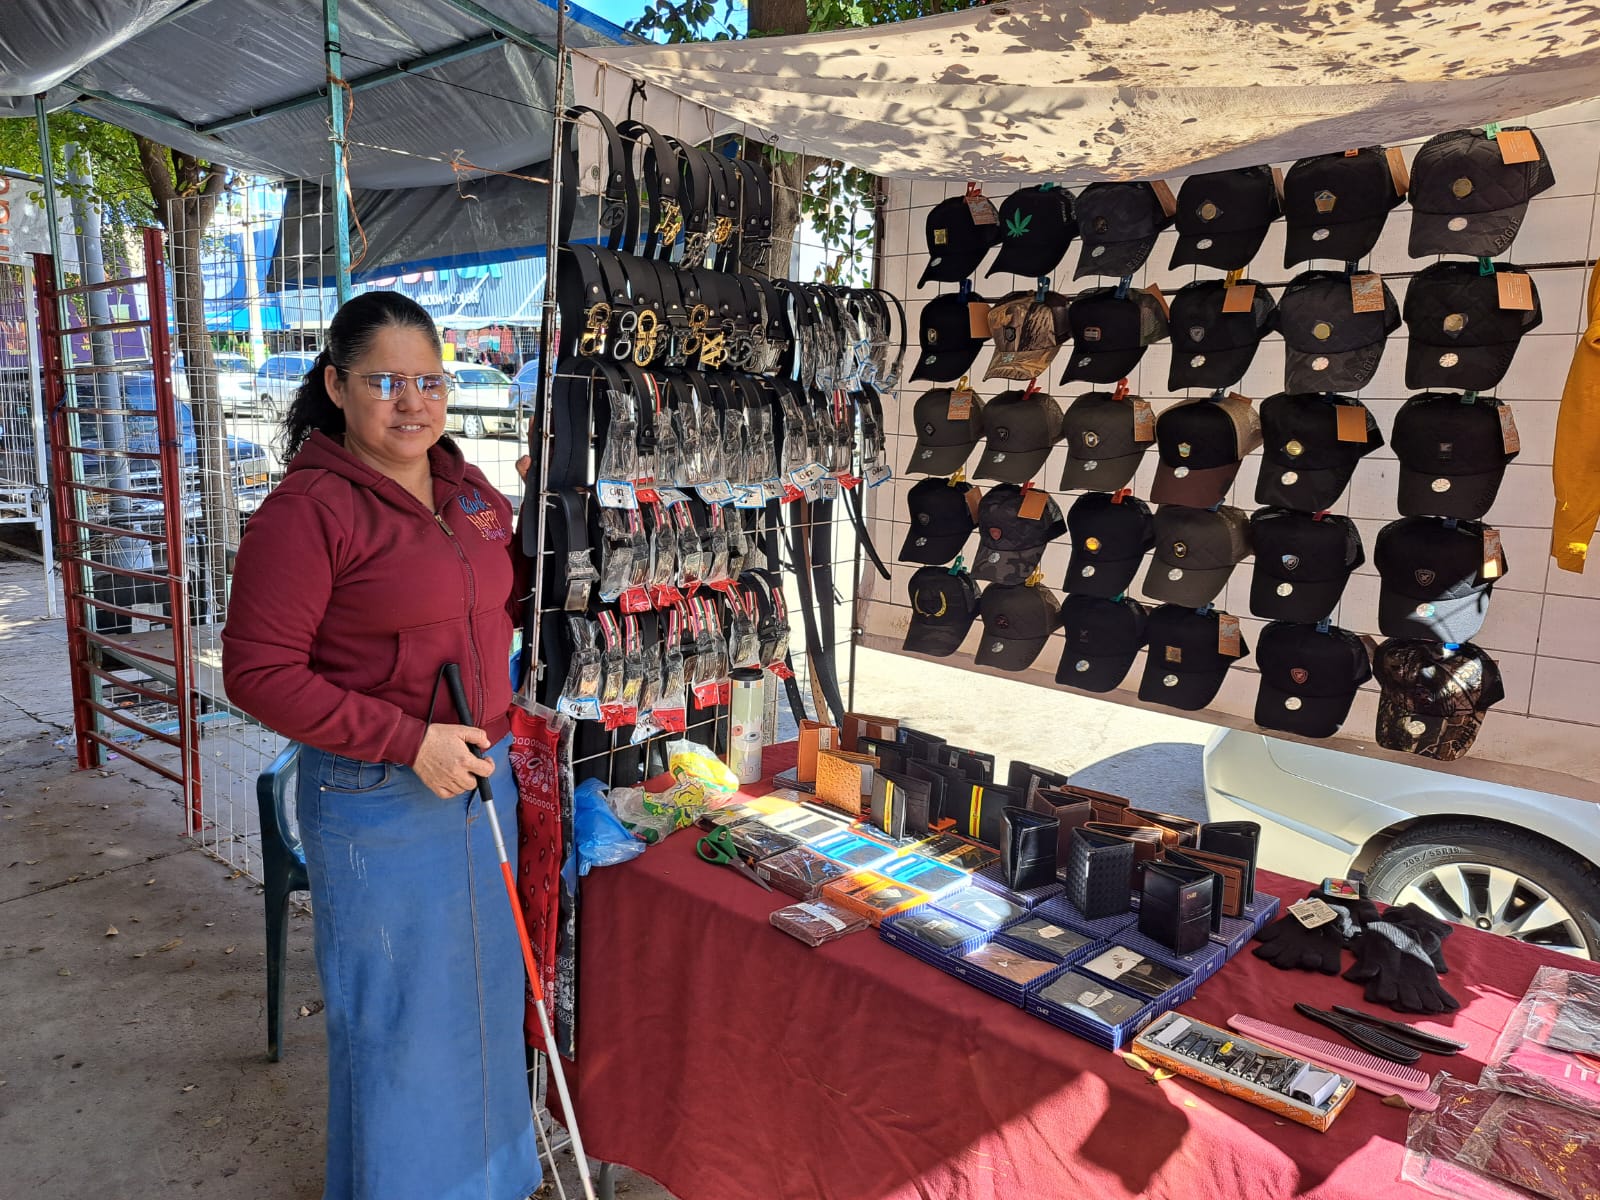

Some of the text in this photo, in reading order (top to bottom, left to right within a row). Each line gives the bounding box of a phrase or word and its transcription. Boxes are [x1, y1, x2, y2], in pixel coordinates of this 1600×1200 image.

[1494, 216, 1521, 250] EAGLE
[1354, 349, 1379, 382] EAGLE
[466, 509, 502, 532] HAPPY
